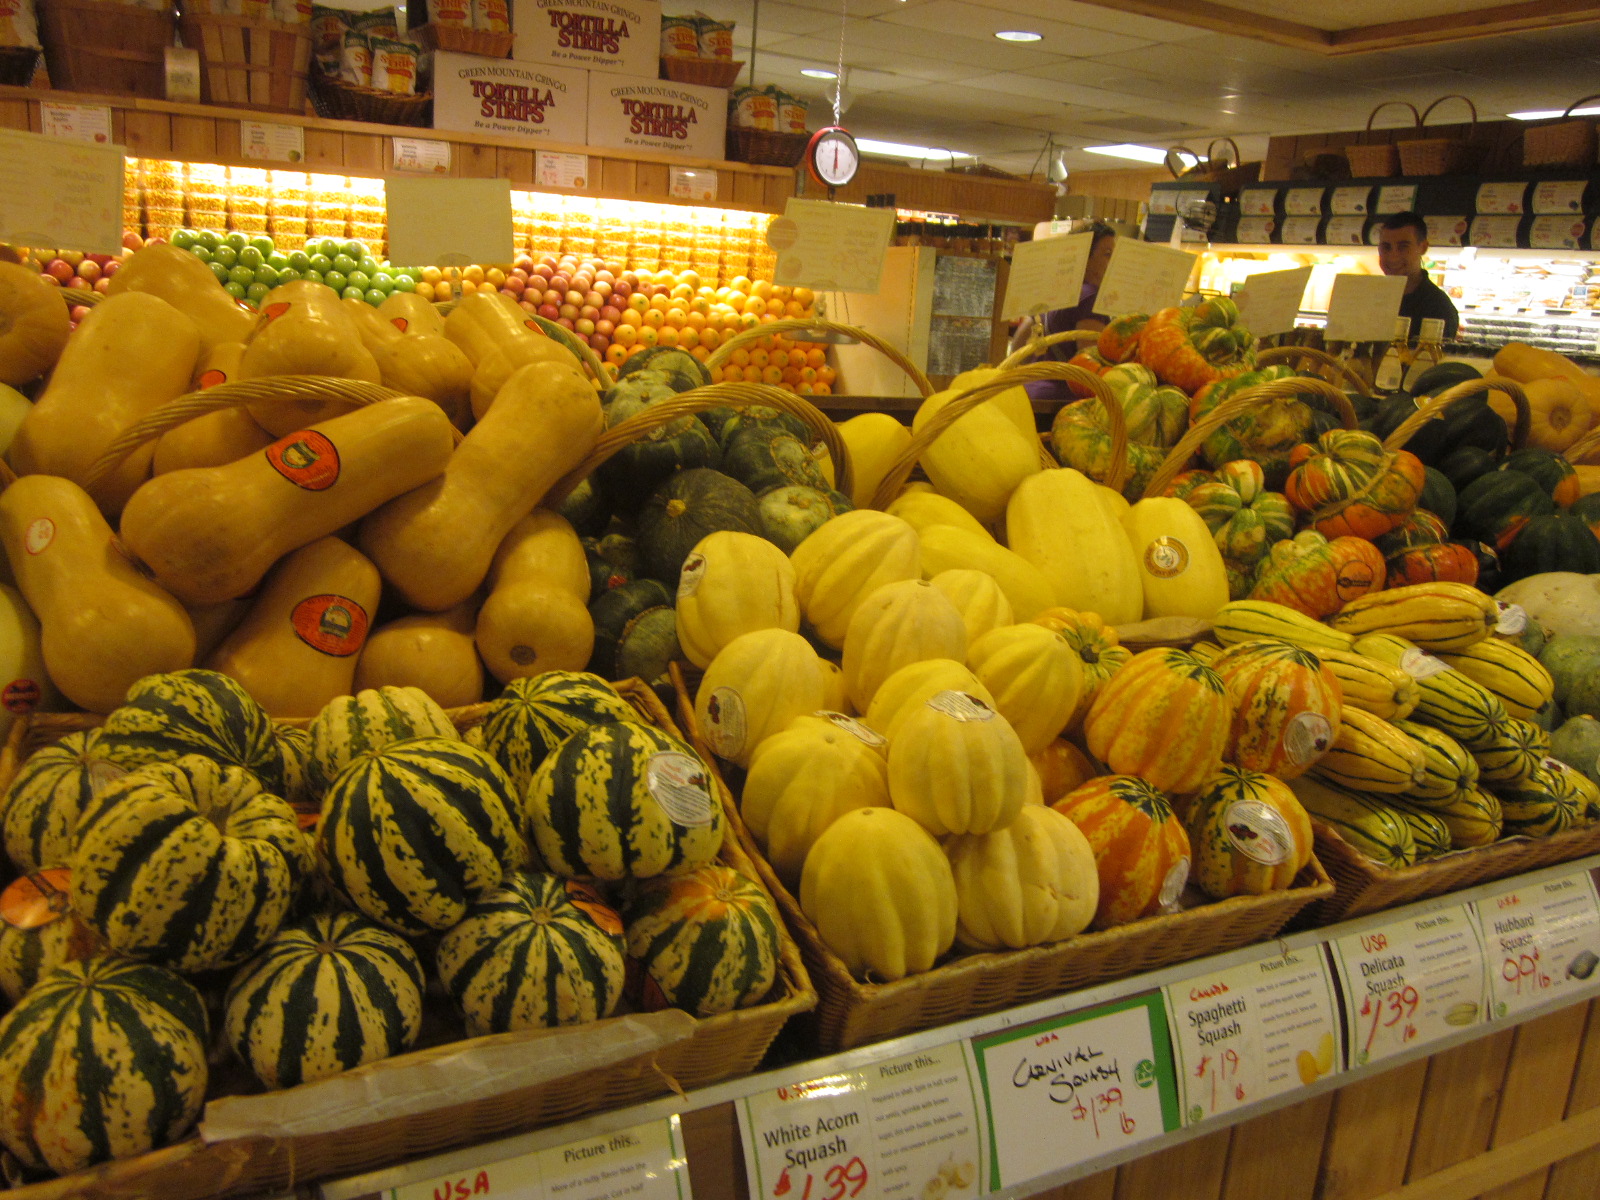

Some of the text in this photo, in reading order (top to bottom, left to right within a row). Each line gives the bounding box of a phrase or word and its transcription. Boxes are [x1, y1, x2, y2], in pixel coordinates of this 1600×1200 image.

[547, 9, 630, 38] TORTILLA
[610, 4, 641, 24] GRINGO
[557, 28, 620, 54] STRIPS
[458, 66, 567, 93] GREEN MOUNTAIN GRINGO
[470, 79, 555, 107] TORTILLA
[610, 86, 709, 110] GREEN MOUNTAIN GRINGO
[480, 98, 545, 124] STRIPS
[621, 97, 698, 124] TORTILLA
[474, 120, 484, 128] Be
[492, 123, 516, 131] Power
[630, 115, 688, 140] STRIPS
[1494, 913, 1535, 934] Hubbard
[1361, 933, 1388, 953] USA
[1259, 959, 1284, 973] Picture
[1360, 954, 1405, 977] Delicata
[1366, 975, 1405, 997] Squash
[1188, 996, 1247, 1028] Spaghetti
[1197, 1019, 1242, 1047] Squash
[879, 1060, 913, 1078] Picture
[763, 1125, 812, 1149] White
[816, 1110, 860, 1135] Acorn
[563, 1144, 606, 1163] Picture
[785, 1134, 848, 1170] Squash
[433, 1170, 490, 1200] USA
